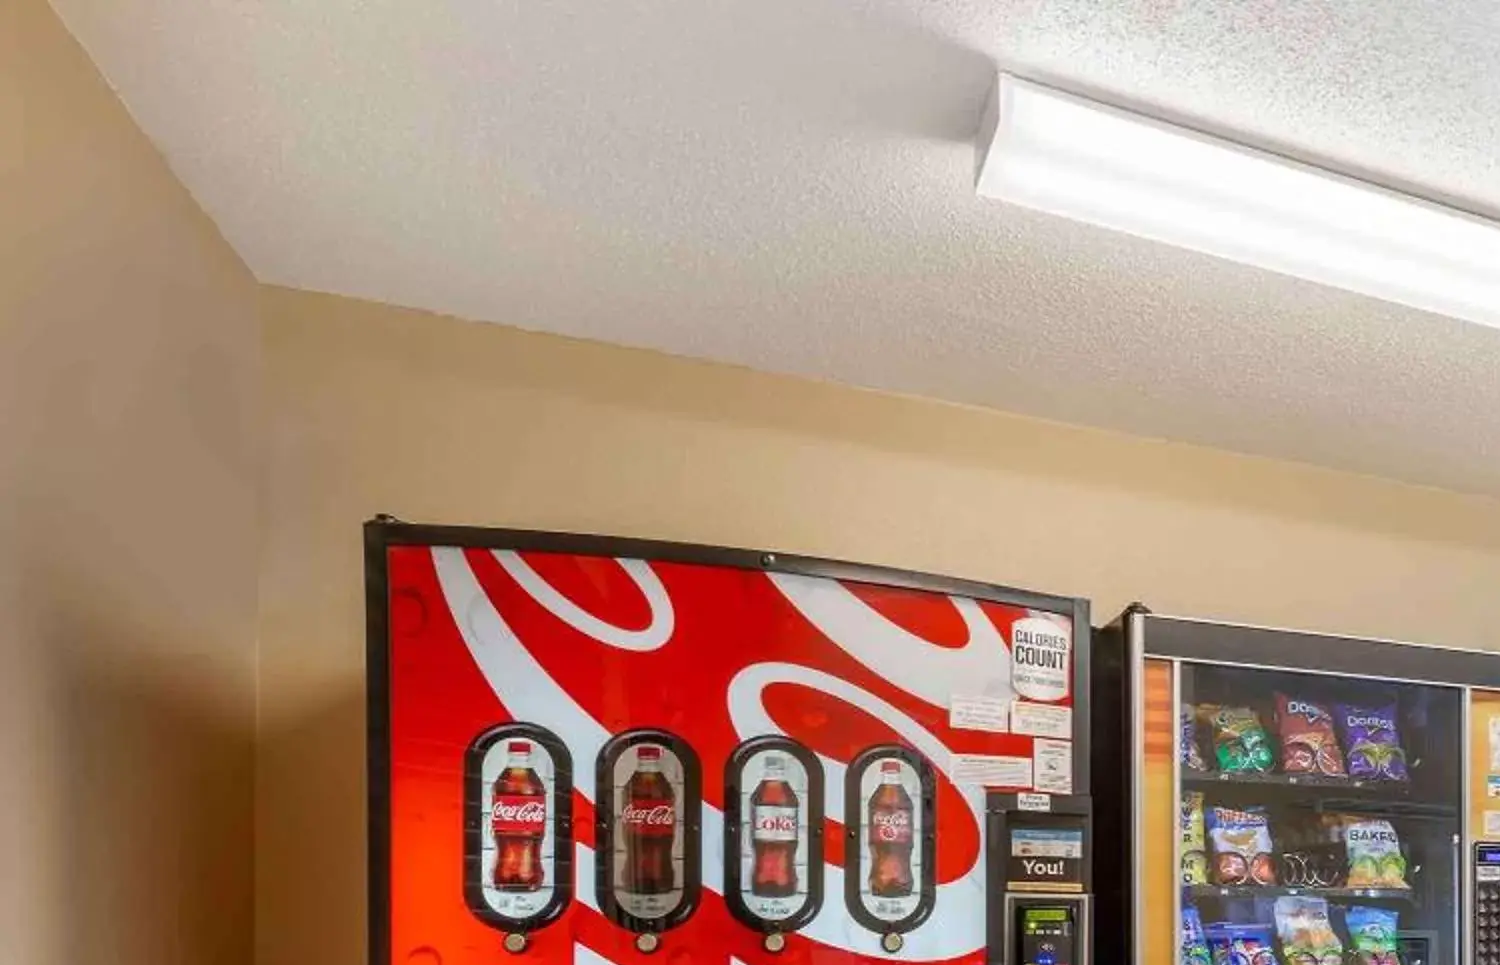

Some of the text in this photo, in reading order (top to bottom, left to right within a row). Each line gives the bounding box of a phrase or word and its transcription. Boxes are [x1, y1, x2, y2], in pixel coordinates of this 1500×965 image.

[1015, 629, 1067, 651] CALORIES
[1015, 645, 1065, 670] COUNT
[1023, 860, 1064, 875] You!
